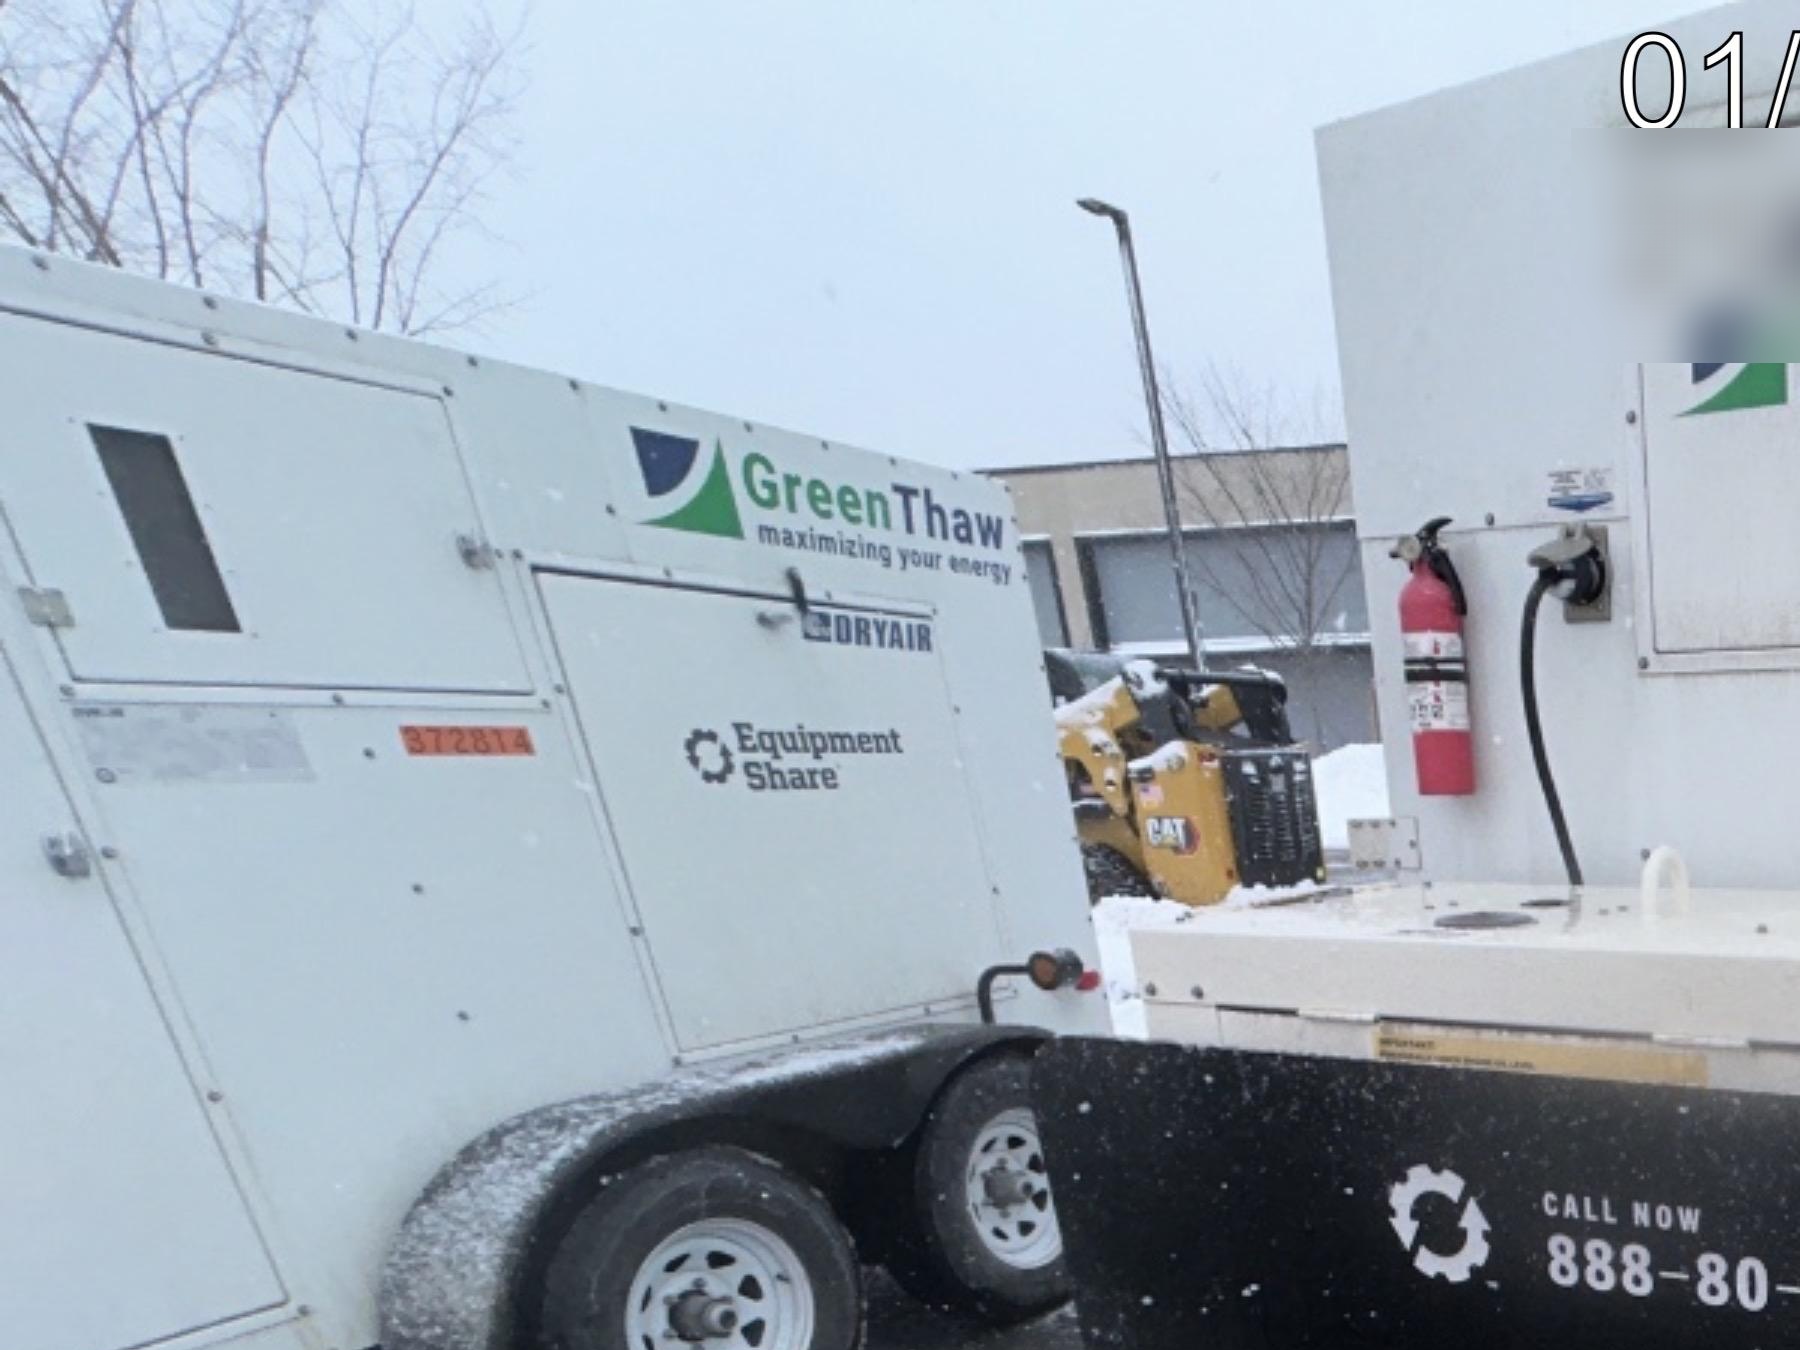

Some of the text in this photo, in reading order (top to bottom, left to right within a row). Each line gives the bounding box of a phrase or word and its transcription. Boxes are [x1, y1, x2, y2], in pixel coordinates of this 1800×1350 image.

[741, 451, 1004, 551] GreenThaw
[758, 522, 1012, 586] maximizing your energy
[834, 614, 933, 653] DRYAIR
[731, 720, 904, 760] Equipment
[743, 760, 839, 791] Share
[1145, 816, 1187, 849] CAT
[1543, 1190, 1701, 1234] CALL NOW
